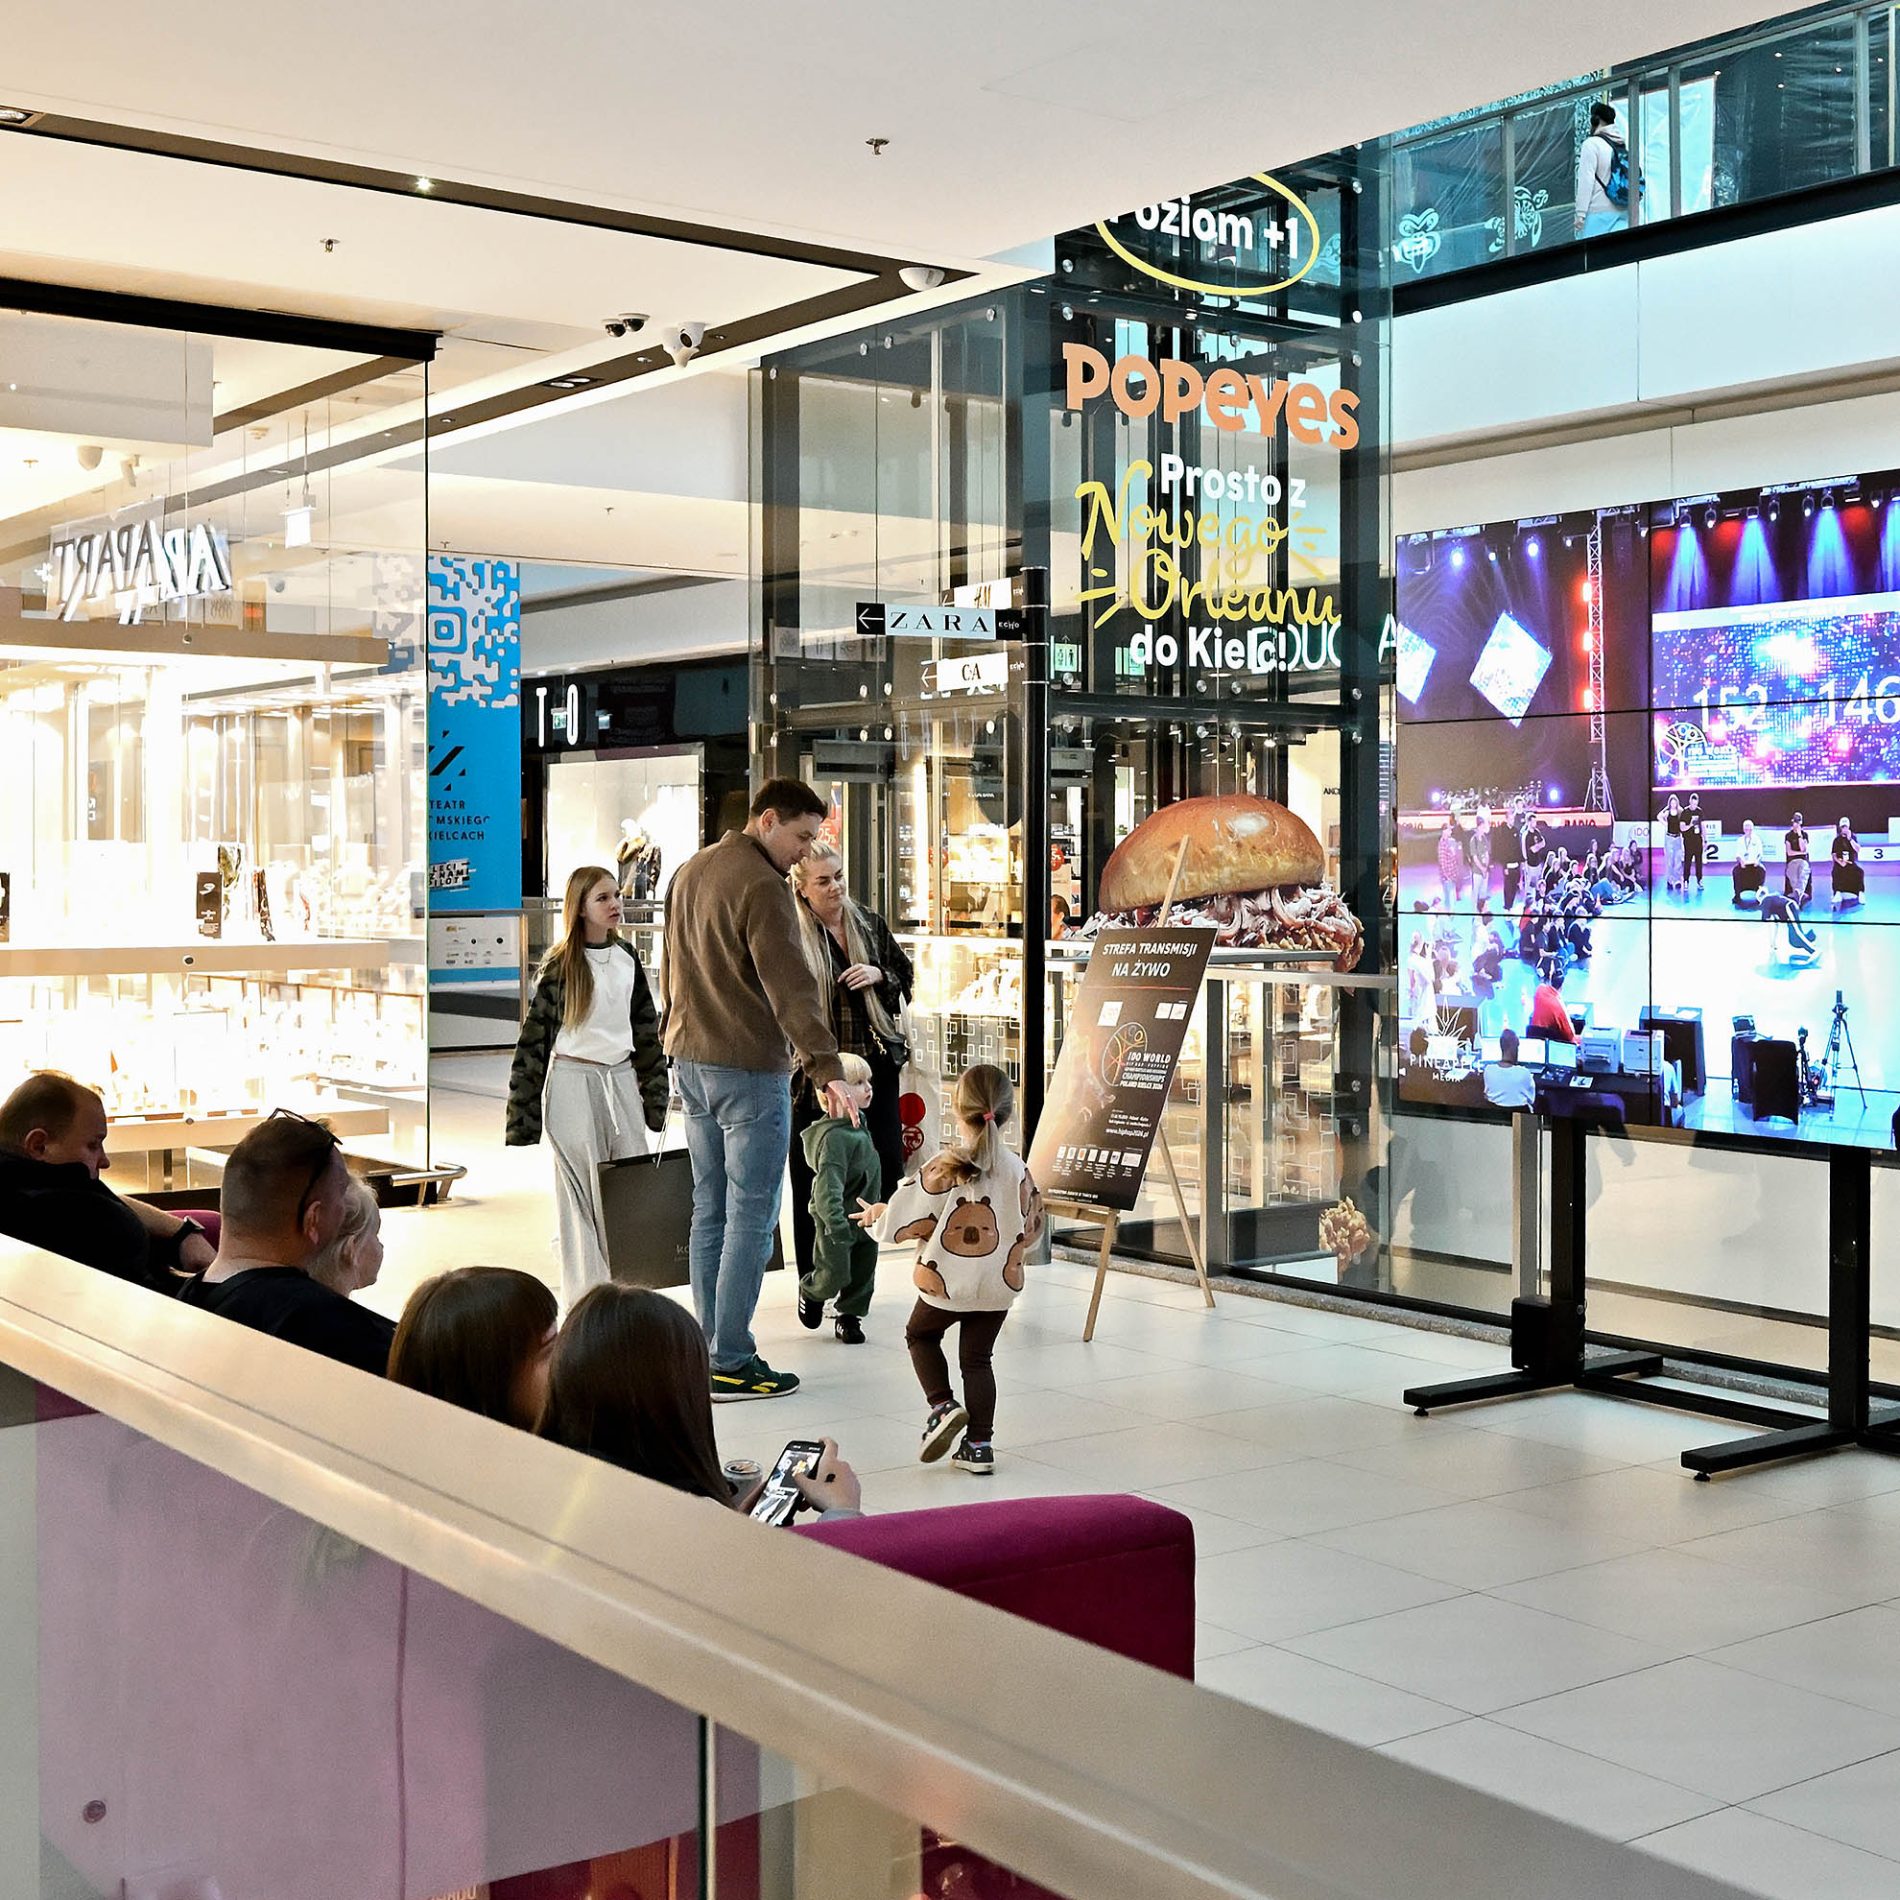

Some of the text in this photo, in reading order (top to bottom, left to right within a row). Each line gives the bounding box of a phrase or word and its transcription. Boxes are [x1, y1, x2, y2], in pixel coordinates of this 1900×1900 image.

[1109, 195, 1299, 259] oziom +1
[1160, 452, 1307, 508] Prosto z
[1074, 459, 1288, 579] Nowego
[1132, 548, 1341, 626] Orleanu
[890, 611, 991, 633] ZARA
[1130, 624, 1178, 668] do
[1692, 684, 1769, 732] 152
[429, 800, 465, 809] TEATR
[1706, 844, 1719, 860] 2
[1874, 848, 1884, 860] 3
[1102, 942, 1197, 957] STREFA TRANSMISJI
[1111, 958, 1171, 977] NA ŻYWO
[1143, 1052, 1171, 1063] WORLD
